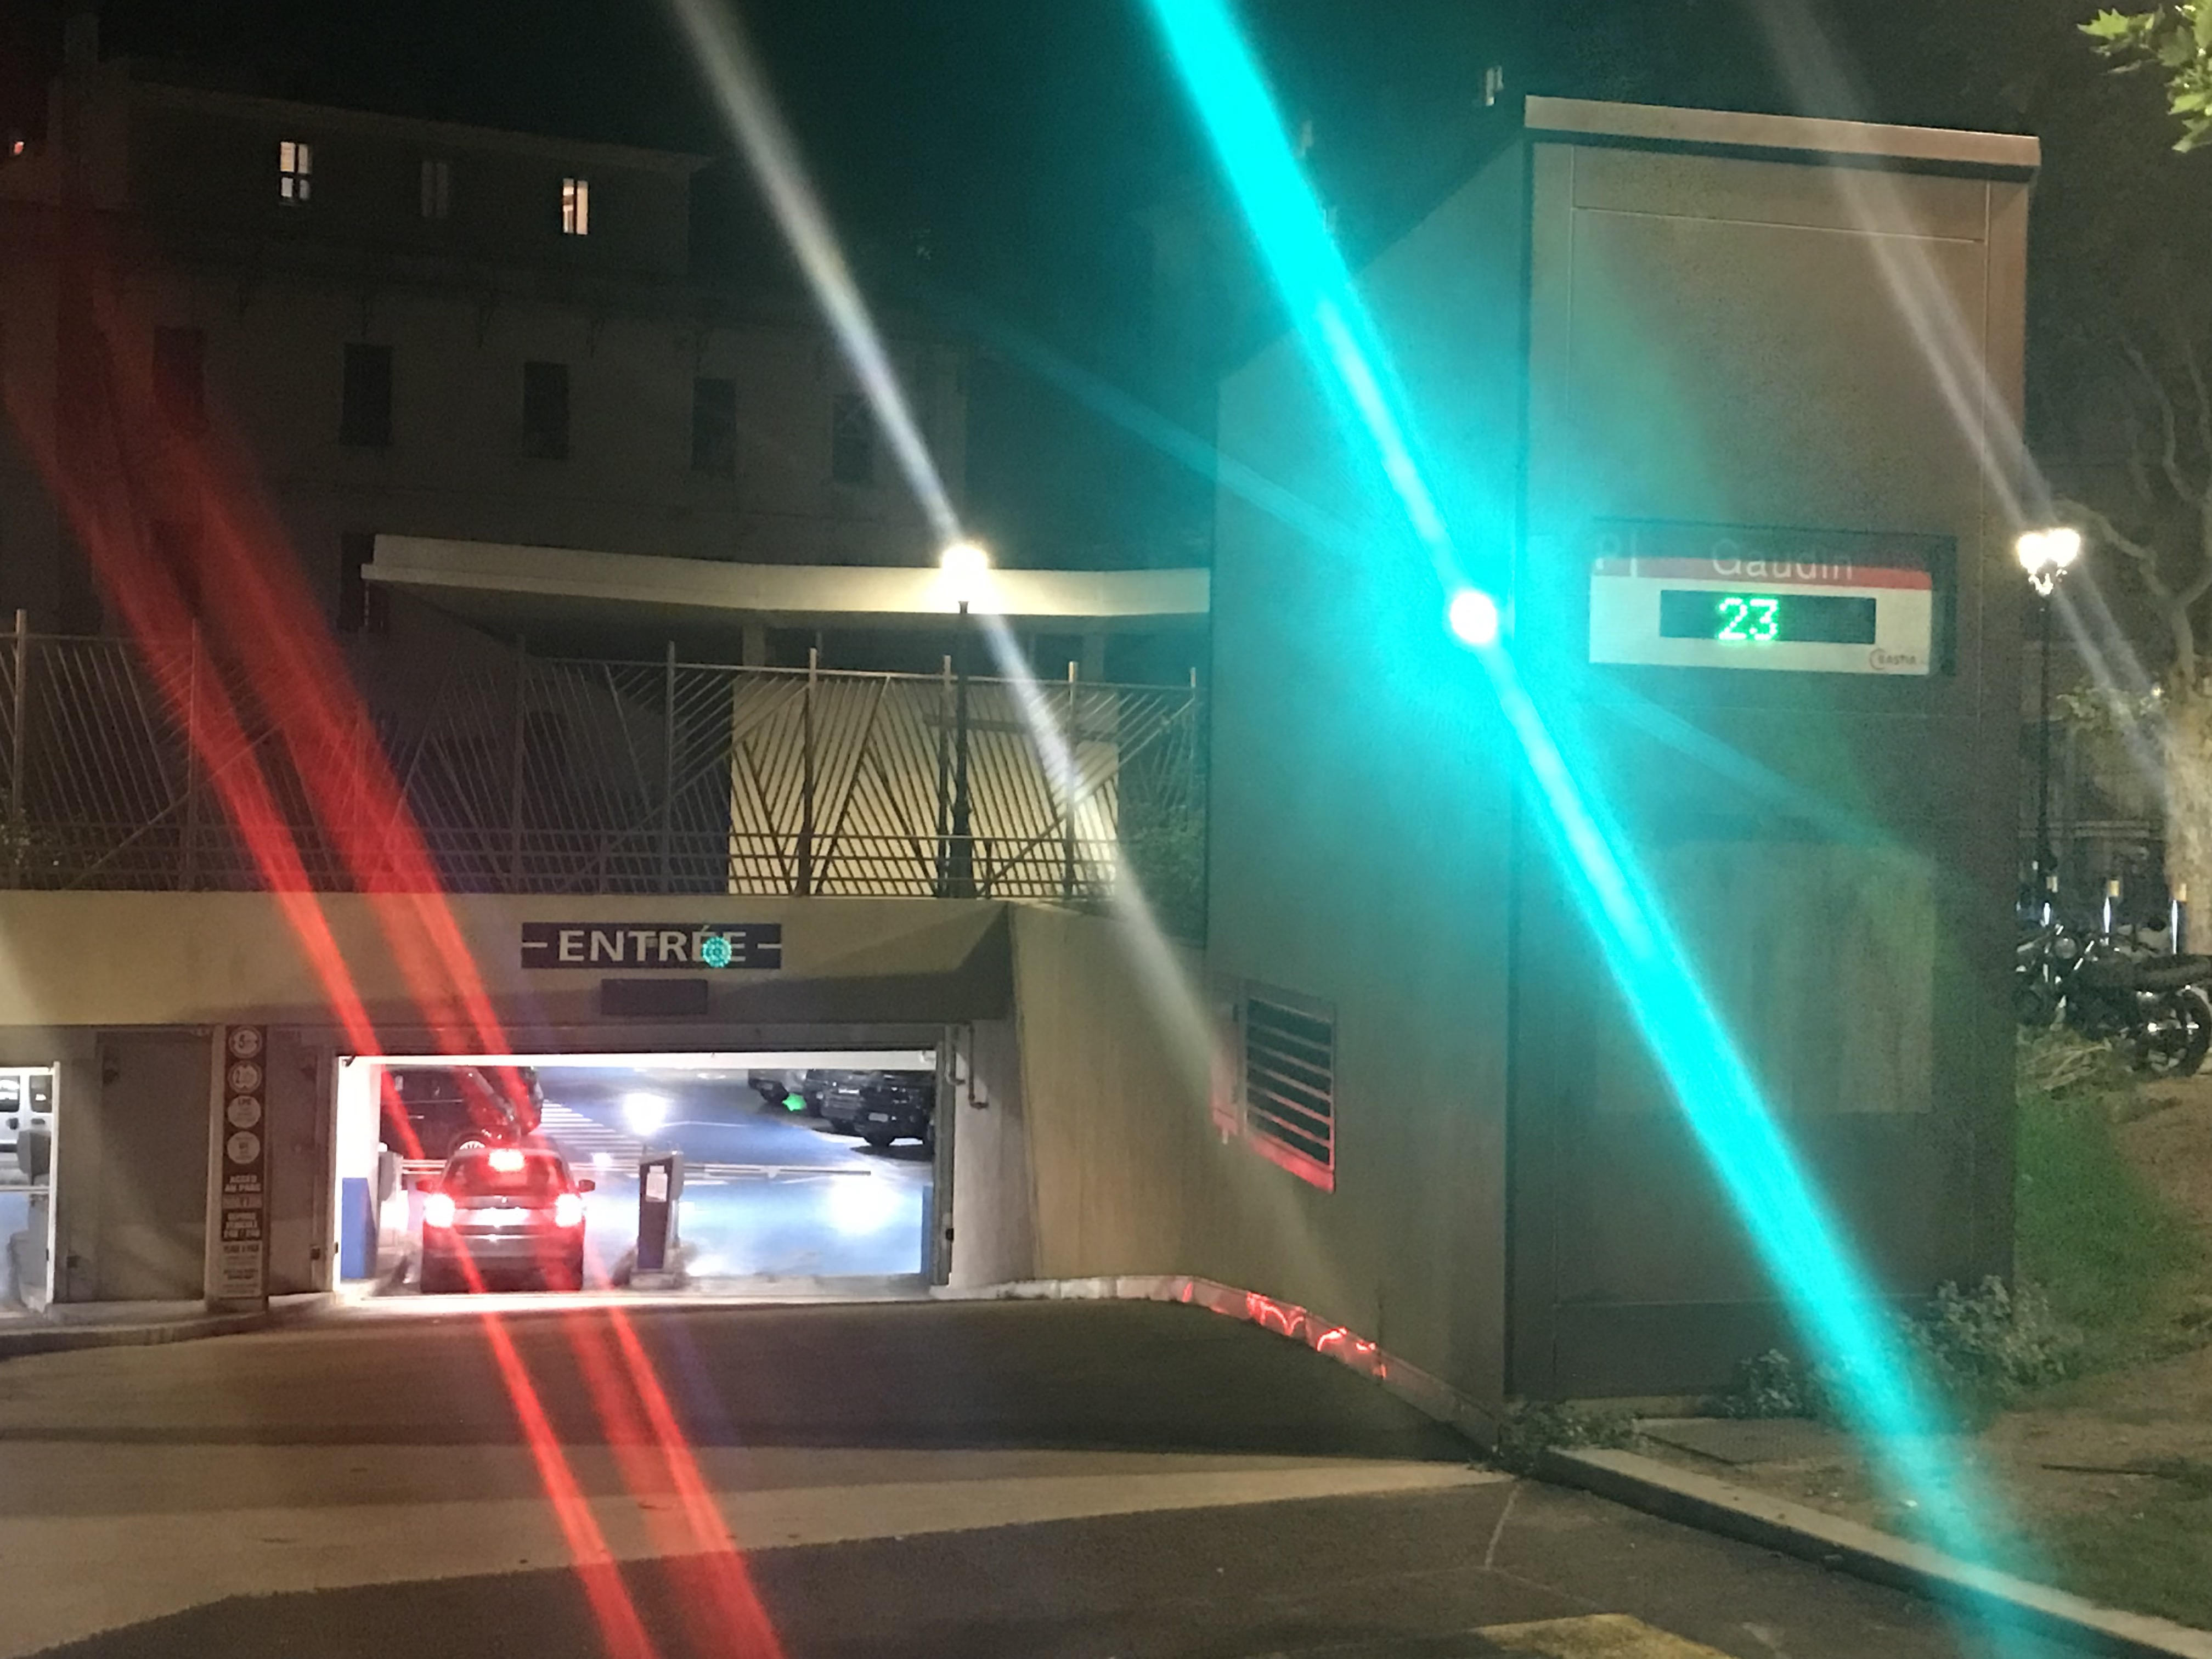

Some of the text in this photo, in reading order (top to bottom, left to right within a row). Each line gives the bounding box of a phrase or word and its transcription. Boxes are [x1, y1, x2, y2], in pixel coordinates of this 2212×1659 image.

[1712, 538, 1852, 580] Gaudin
[1717, 597, 1779, 641] 23
[558, 924, 747, 962] ENTRÉE
